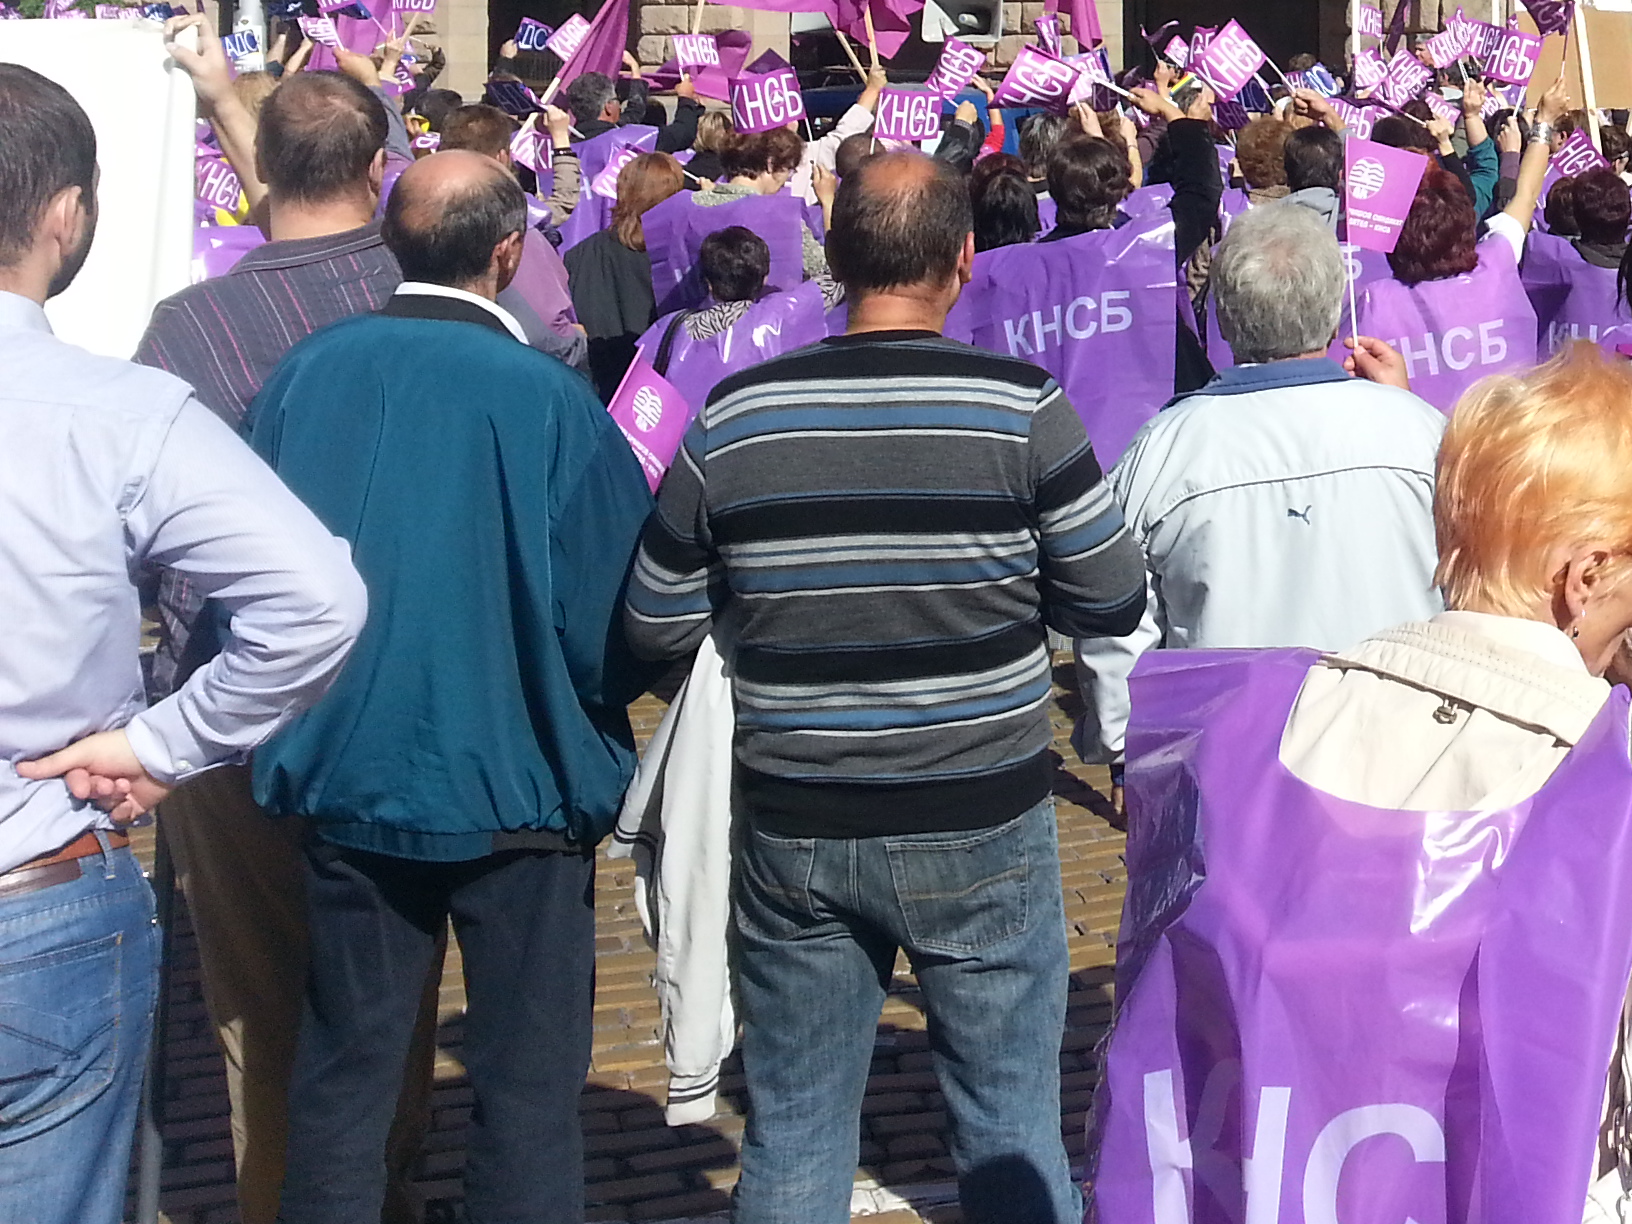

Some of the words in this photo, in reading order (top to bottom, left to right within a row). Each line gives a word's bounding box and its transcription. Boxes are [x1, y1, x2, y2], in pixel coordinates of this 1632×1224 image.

[518, 24, 548, 51] ДС
[674, 36, 719, 66] КНСБ
[1483, 34, 1533, 80] НСБ
[1195, 25, 1262, 98] КНСБ
[1355, 49, 1388, 87] НСБ
[1387, 49, 1430, 91] КНСБ
[731, 73, 803, 129] КНСБ
[874, 95, 940, 136] КНСБ
[1238, 79, 1266, 112] ДС
[1553, 132, 1604, 178] НСБ
[1003, 290, 1133, 357] КНСБ
[1387, 319, 1508, 378] НСБ
